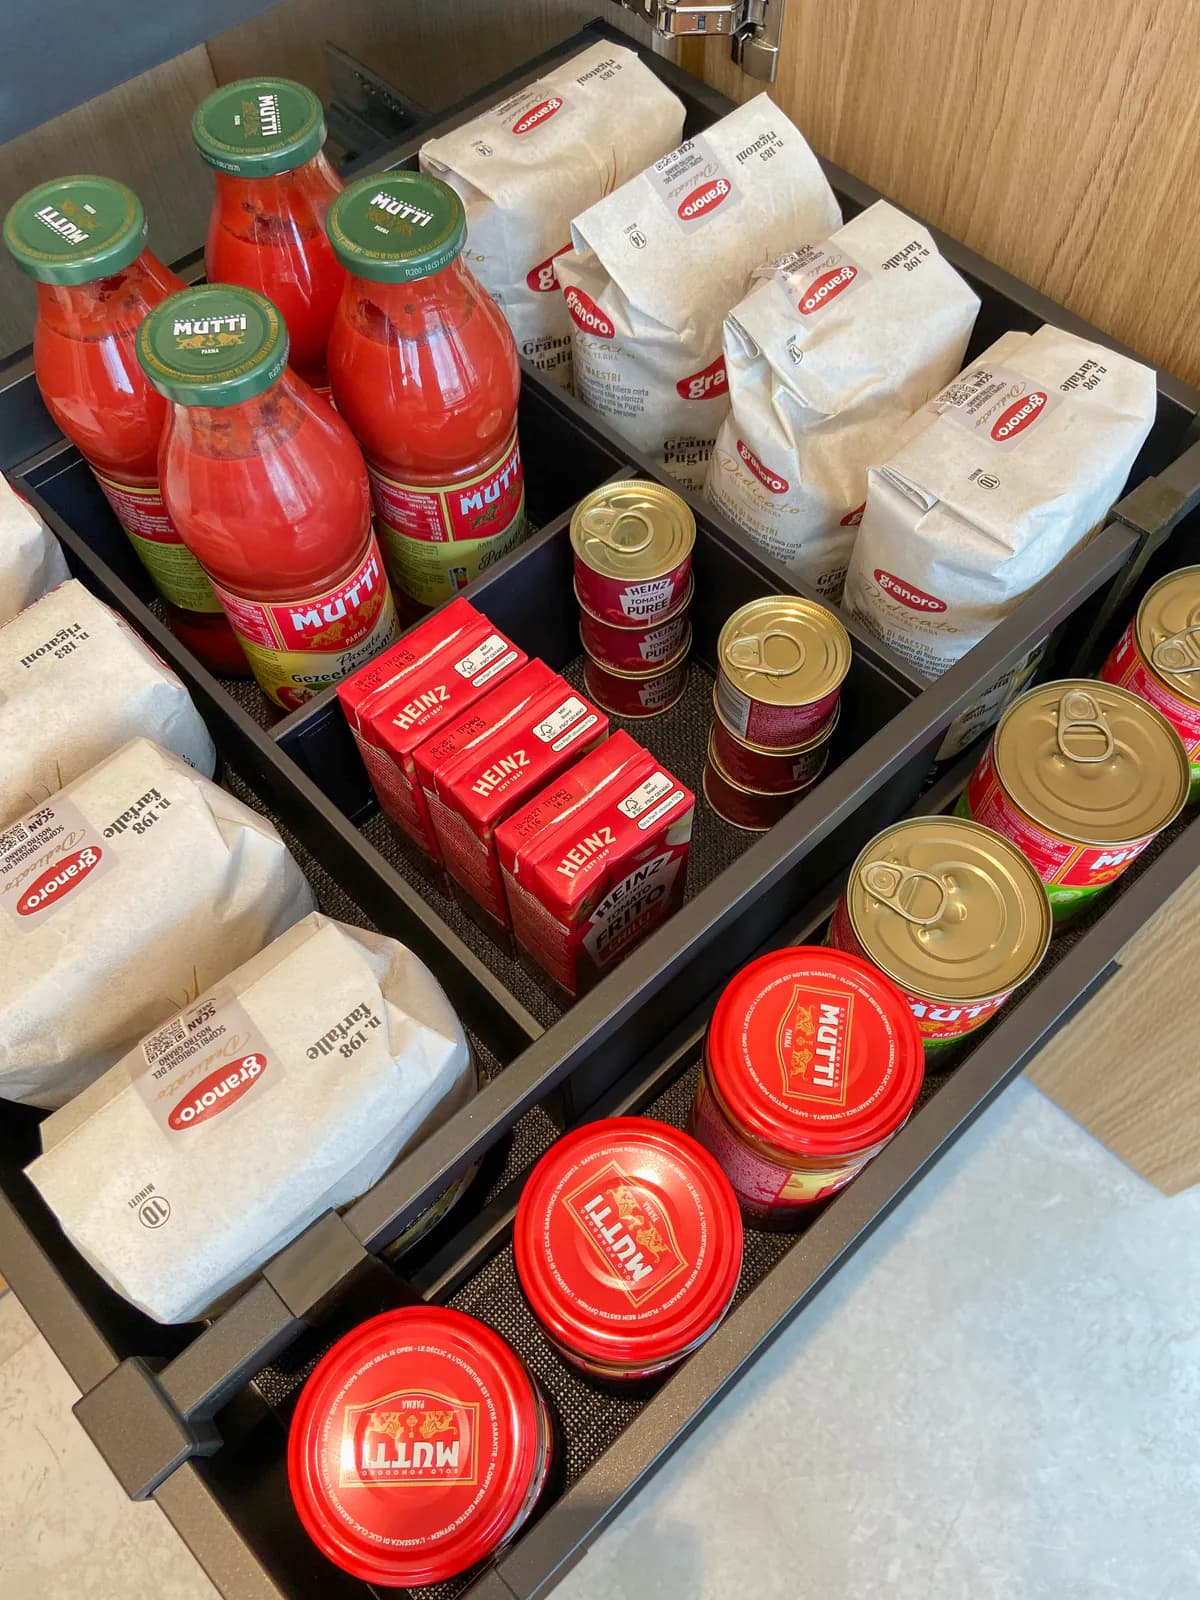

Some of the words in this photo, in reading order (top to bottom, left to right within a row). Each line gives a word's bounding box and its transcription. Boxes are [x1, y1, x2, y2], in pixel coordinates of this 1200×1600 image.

[576, 59, 616, 86] rigatoni
[599, 68, 615, 81] 183
[257, 94, 278, 137] MUTTI
[517, 98, 562, 132] granoro
[736, 130, 778, 165] rigatoni
[759, 146, 776, 162] 183
[682, 178, 729, 217] granoro
[369, 193, 433, 227] MUTTI
[37, 205, 89, 244] MUTTI
[881, 239, 923, 272] farfalle
[902, 256, 922, 272] 198
[803, 266, 855, 310] granoro
[566, 291, 610, 335] granoro
[173, 317, 248, 336] MUTTI
[523, 336, 572, 356] Grano
[974, 372, 993, 389] SCAN
[1059, 358, 1099, 392] farfalle
[1096, 365, 1108, 375] n.
[1082, 373, 1101, 391] 198
[624, 403, 645, 412] Puglia
[998, 394, 1045, 437] granoro
[663, 449, 713, 465] Pugli
[741, 446, 782, 490] granoro
[459, 445, 521, 516] MUTTI
[290, 556, 379, 631] MUTTI
[630, 580, 669, 596] HEINZ
[631, 592, 665, 606] TOMATO
[879, 573, 940, 609] granoro
[627, 600, 669, 616] PUREE
[20, 622, 83, 669] rigatoni
[76, 631, 90, 642] n.
[345, 627, 368, 646] PARMA
[898, 634, 934, 653] MAESTRI
[54, 641, 78, 660] 183
[336, 632, 382, 667] Passata
[391, 684, 451, 731] HEINZ
[430, 704, 444, 719] 1869
[471, 749, 531, 798] HEINZ
[509, 770, 524, 784] 1869
[103, 787, 163, 839] farfalle
[155, 797, 172, 810] n.
[28, 808, 56, 833] SCAN
[132, 810, 160, 835] 198
[25, 826, 52, 848] NOSTRO
[43, 824, 65, 846] SCOPRI
[3, 828, 87, 894] Dedicato
[4, 842, 27, 863] GRANO
[13, 841, 44, 867] L'ORIGINE
[556, 826, 617, 879] HEINZ
[595, 849, 610, 864] 1869
[0, 861, 14, 876] DEL
[26, 847, 98, 908] granoro
[596, 857, 666, 918] HEINZ
[607, 884, 652, 922] TOMATO
[596, 884, 666, 949] FRITO
[187, 1005, 217, 1032] SCAN
[364, 1015, 382, 1029] n.
[743, 1004, 756, 1023] DÉCLIC
[879, 1013, 893, 1035] ÖFFNEN
[183, 1025, 213, 1049] NOSTRO
[199, 1024, 227, 1045] SCOPRI
[305, 1002, 373, 1061] farfalle
[784, 1028, 793, 1049] PARMA
[158, 1044, 184, 1066] GRANO
[167, 1039, 202, 1071] L'ORIGINE
[338, 1030, 369, 1059] 198
[812, 1003, 840, 1089] MUTTI
[151, 1063, 169, 1081] DEL
[156, 1031, 251, 1102] Dedicato
[179, 1054, 262, 1122] granoro
[880, 1073, 890, 1086] CLIC
[872, 1084, 884, 1098] CLAC
[787, 1105, 809, 1117] SAFETY
[844, 1094, 875, 1116] GARANTISCE
[579, 1151, 601, 1166] SAFETY
[127, 1183, 156, 1209] MINUTI
[689, 1188, 703, 1211] DÉCLIC
[544, 1192, 559, 1230] GARANTISCE
[543, 1230, 551, 1248] CLAC
[583, 1194, 653, 1282] MUTTI
[545, 1247, 554, 1263] CLIC
[693, 1256, 703, 1270] EST
[682, 1268, 698, 1289] NOTRE
[575, 1297, 599, 1315] ÖFFNEN
[660, 1286, 687, 1310] GARANTIE
[597, 1309, 622, 1319] ERSTEN
[636, 1307, 659, 1319] PLOPPT
[417, 1344, 425, 1352] LE
[425, 1344, 447, 1358] DÉCLIC
[342, 1372, 358, 1391] POPS
[355, 1358, 374, 1376] WHEN
[372, 1350, 390, 1364] SEAL
[395, 1345, 413, 1354] OPEN
[451, 1354, 484, 1388] L'OUVERTURE
[479, 1385, 490, 1399] EST
[401, 1399, 425, 1409] PARMA
[485, 1397, 497, 1422] NOTRE
[490, 1421, 499, 1457] GARANTIE
[361, 1440, 460, 1469] MUTTI
[481, 1461, 496, 1490] PLOPPT
[471, 1487, 485, 1506] BEIM
[453, 1502, 475, 1526] ERSTEN
[351, 1520, 369, 1536] CLAC
[366, 1530, 383, 1542] CLIC
[429, 1521, 456, 1540] ÖFFNEN
[389, 1536, 425, 1545] L'ASSENZA
